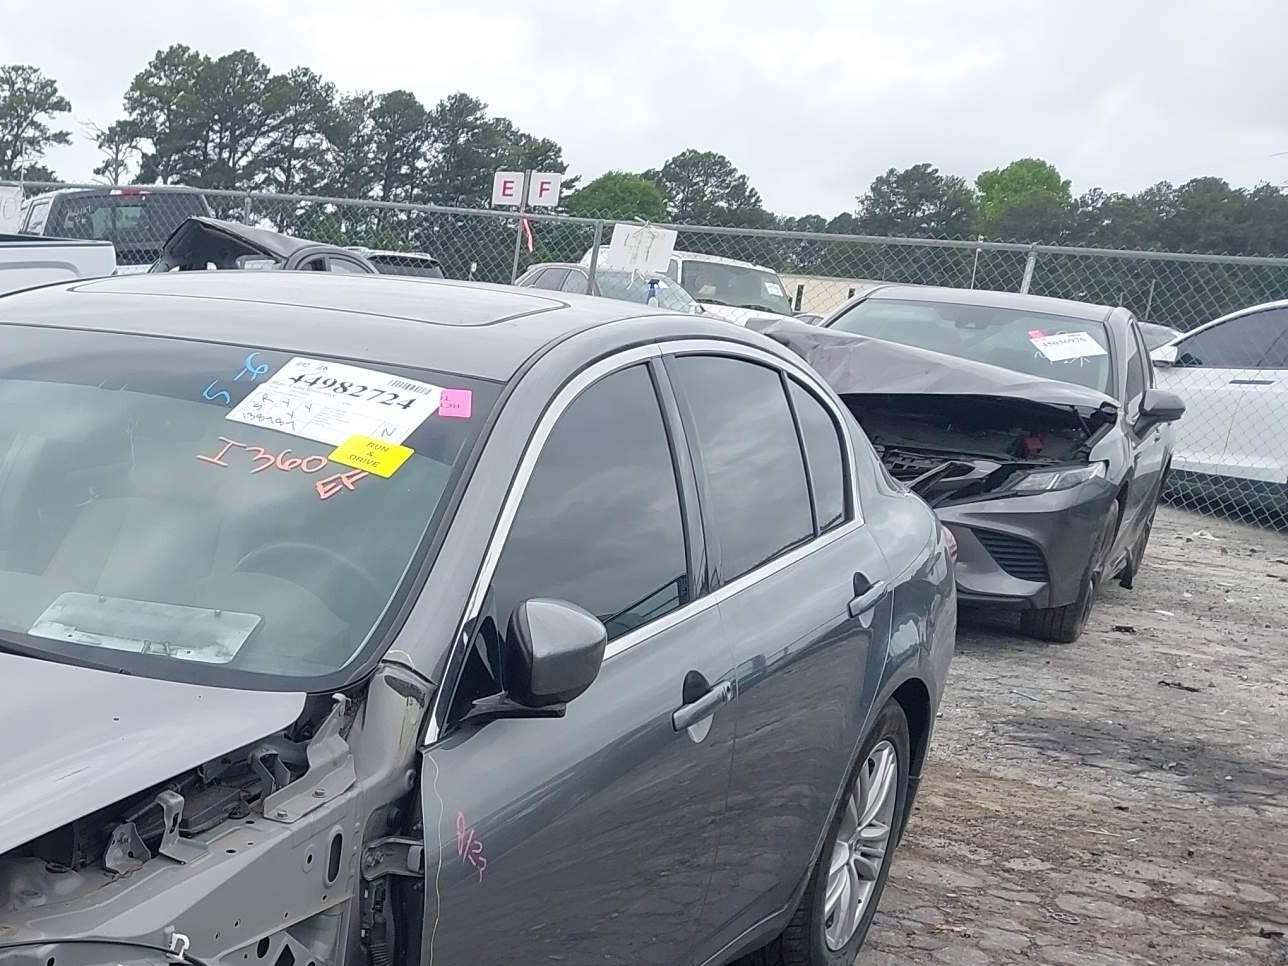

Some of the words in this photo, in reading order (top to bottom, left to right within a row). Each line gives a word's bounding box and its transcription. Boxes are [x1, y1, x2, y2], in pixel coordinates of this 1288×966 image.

[502, 180, 515, 197] E
[538, 181, 552, 198] F
[288, 374, 417, 411] 44982724
[366, 442, 390, 452] RUN
[348, 454, 380, 468] DRIVE
